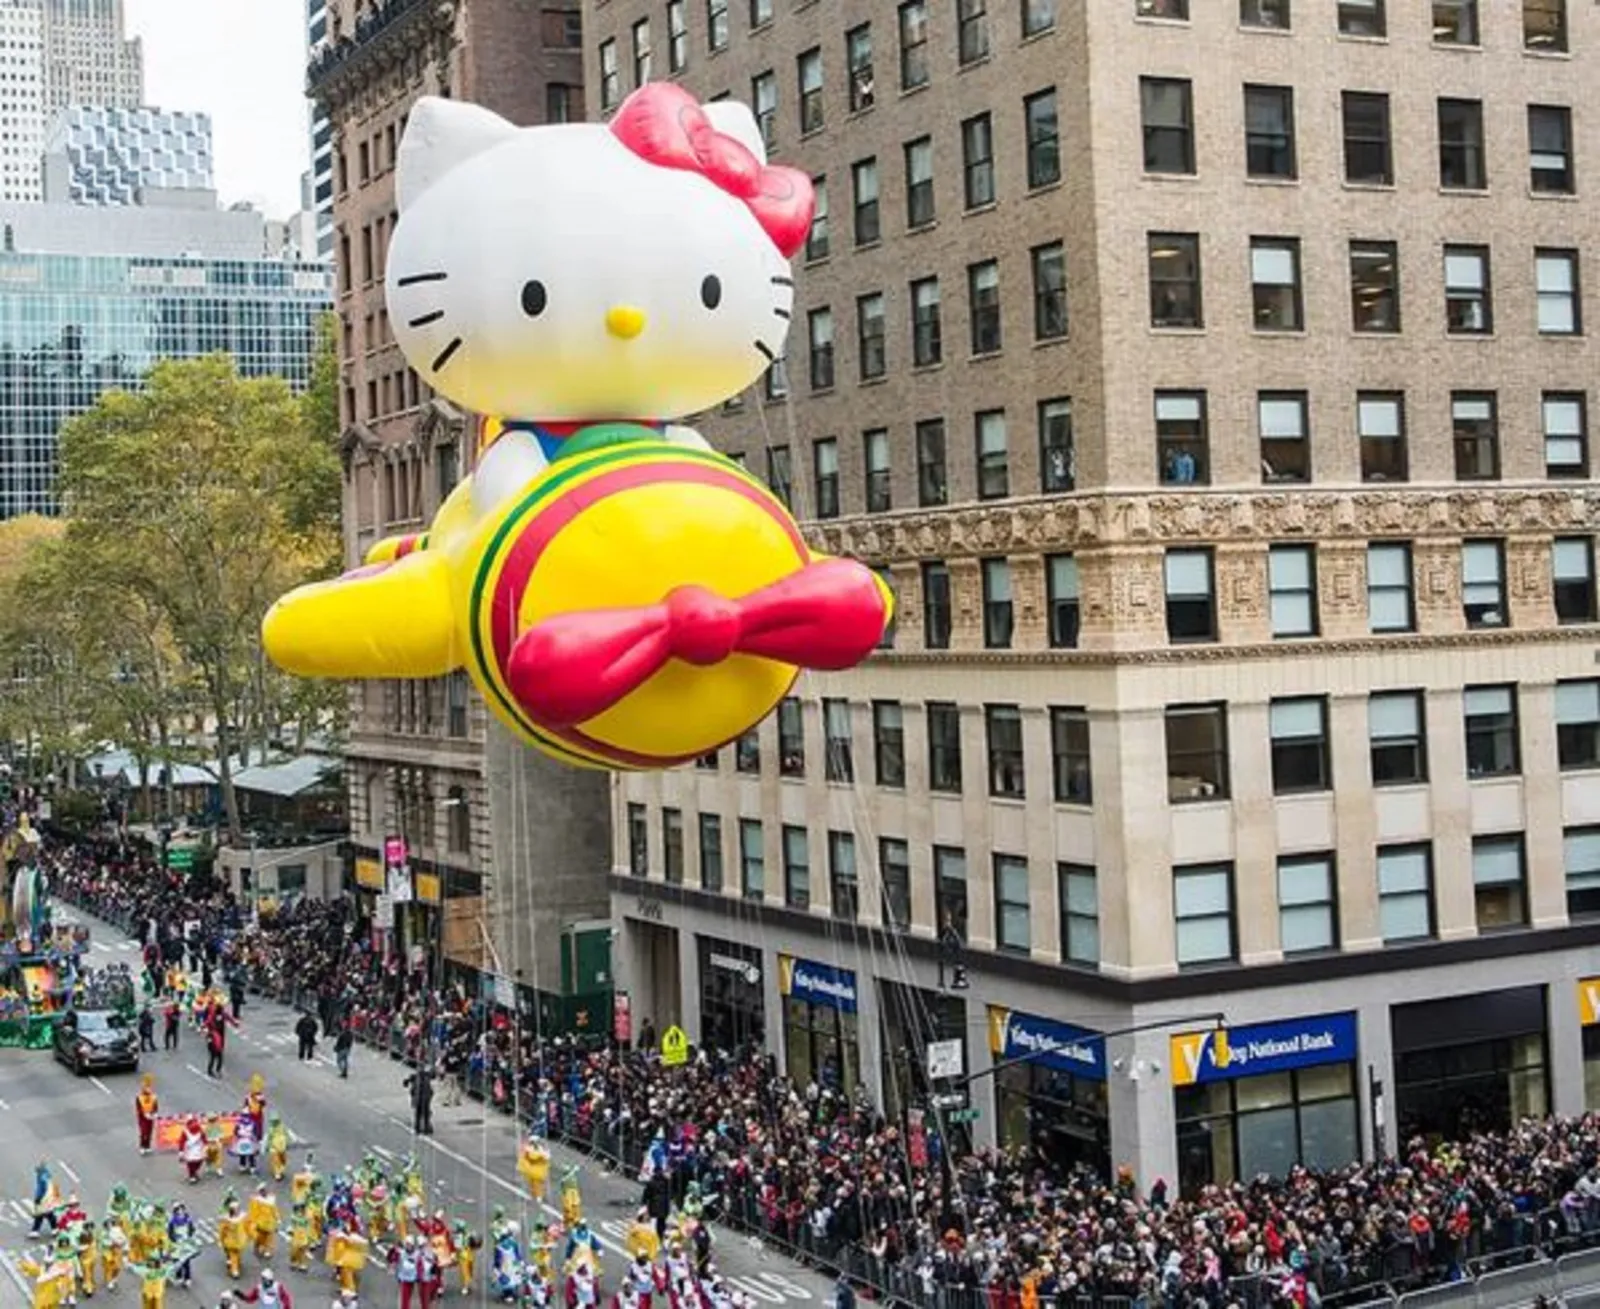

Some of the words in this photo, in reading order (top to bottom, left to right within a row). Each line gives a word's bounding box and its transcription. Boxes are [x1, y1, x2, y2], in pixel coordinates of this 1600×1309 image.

[1207, 1044, 1248, 1066] Vley
[1249, 1035, 1299, 1059] National
[1302, 1031, 1335, 1050] Bank
[726, 1271, 813, 1304] US
